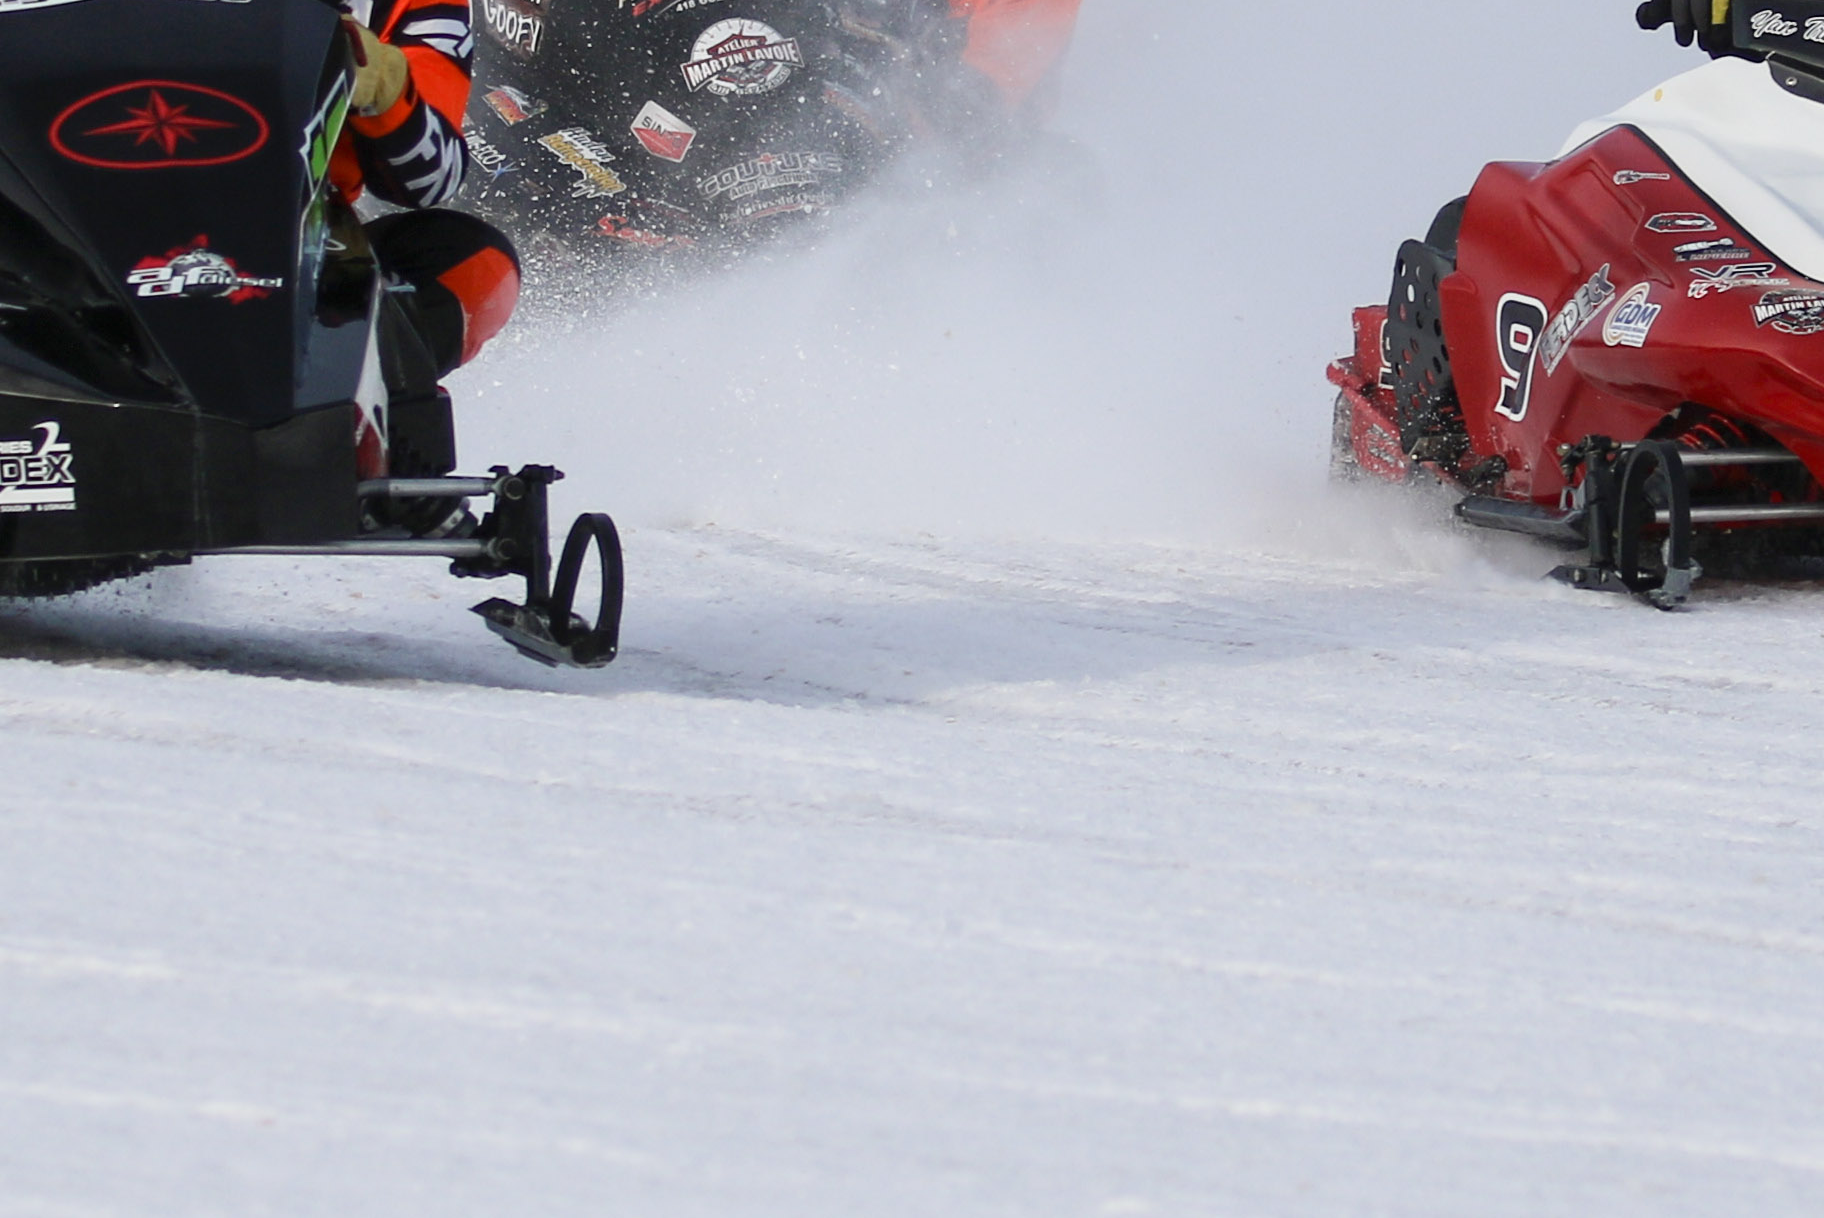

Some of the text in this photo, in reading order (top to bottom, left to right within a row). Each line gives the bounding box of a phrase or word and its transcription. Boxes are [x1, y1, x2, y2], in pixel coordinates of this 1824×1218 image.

[676, 0, 696, 12] 418
[1750, 9, 1798, 38] Yan
[717, 38, 759, 55] ATELIER
[686, 51, 745, 88] MARTIN
[745, 42, 799, 63] LAVOIE
[1614, 303, 1659, 327] GDM
[1754, 300, 1804, 323] MARTIN
[1495, 293, 1549, 422] 9
